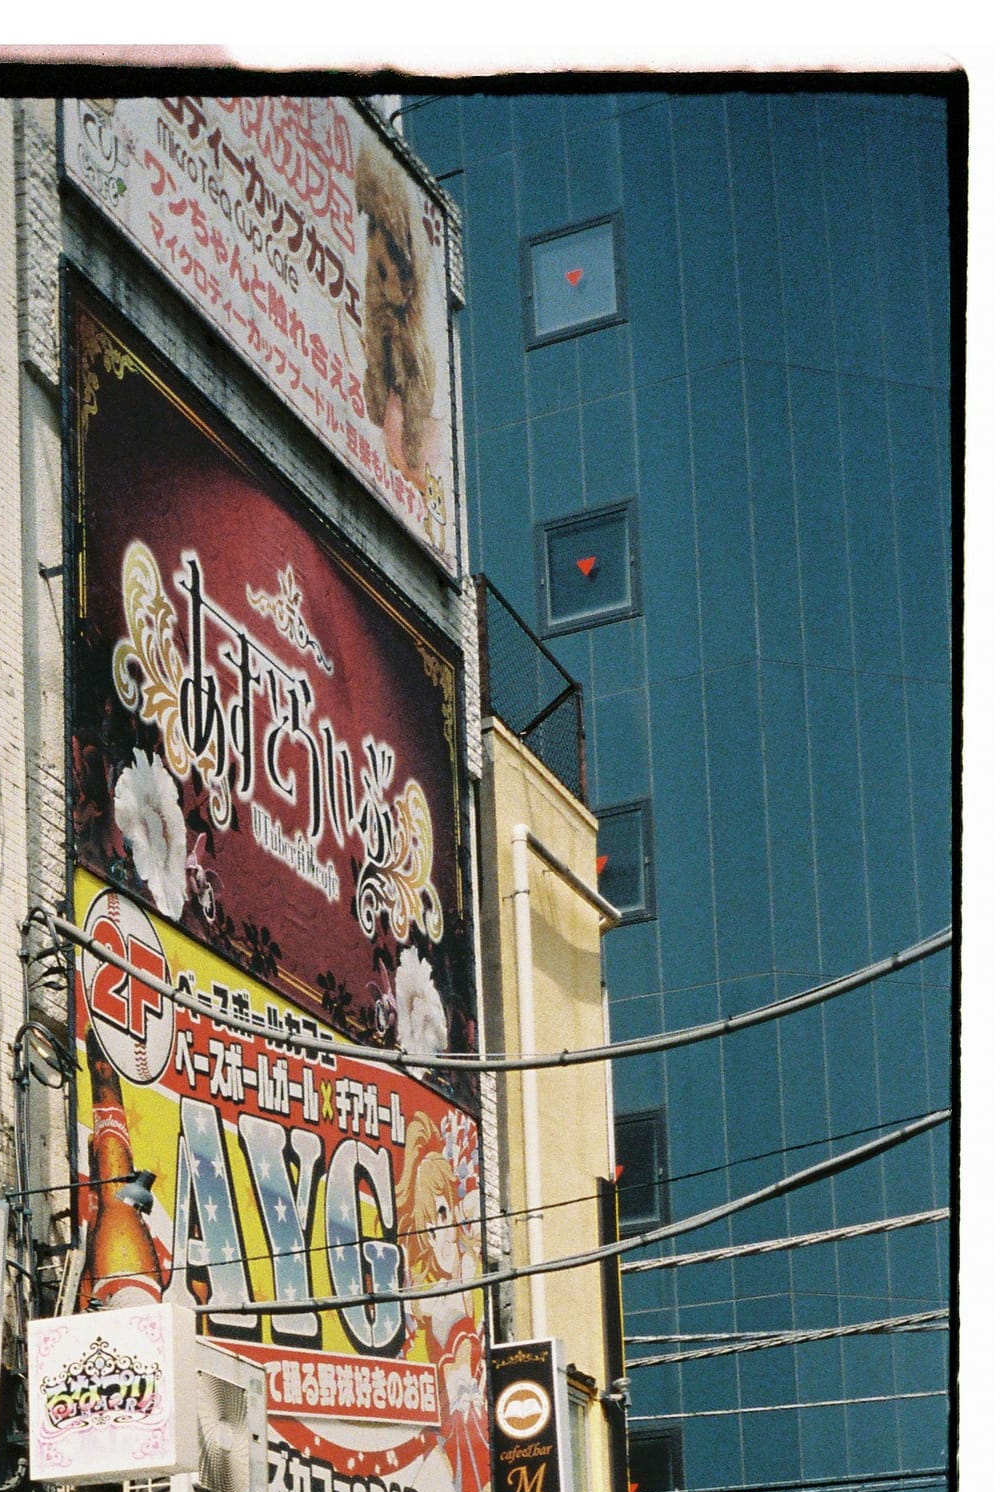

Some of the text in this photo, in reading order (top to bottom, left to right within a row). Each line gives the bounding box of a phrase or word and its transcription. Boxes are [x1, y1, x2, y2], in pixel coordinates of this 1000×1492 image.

[143, 148, 365, 420] ワンちゃんと触れ合える
[91, 915, 166, 1042] 2F
[164, 1097, 403, 1351] AYG
[264, 1359, 436, 1412] て踊る野球好きのお店
